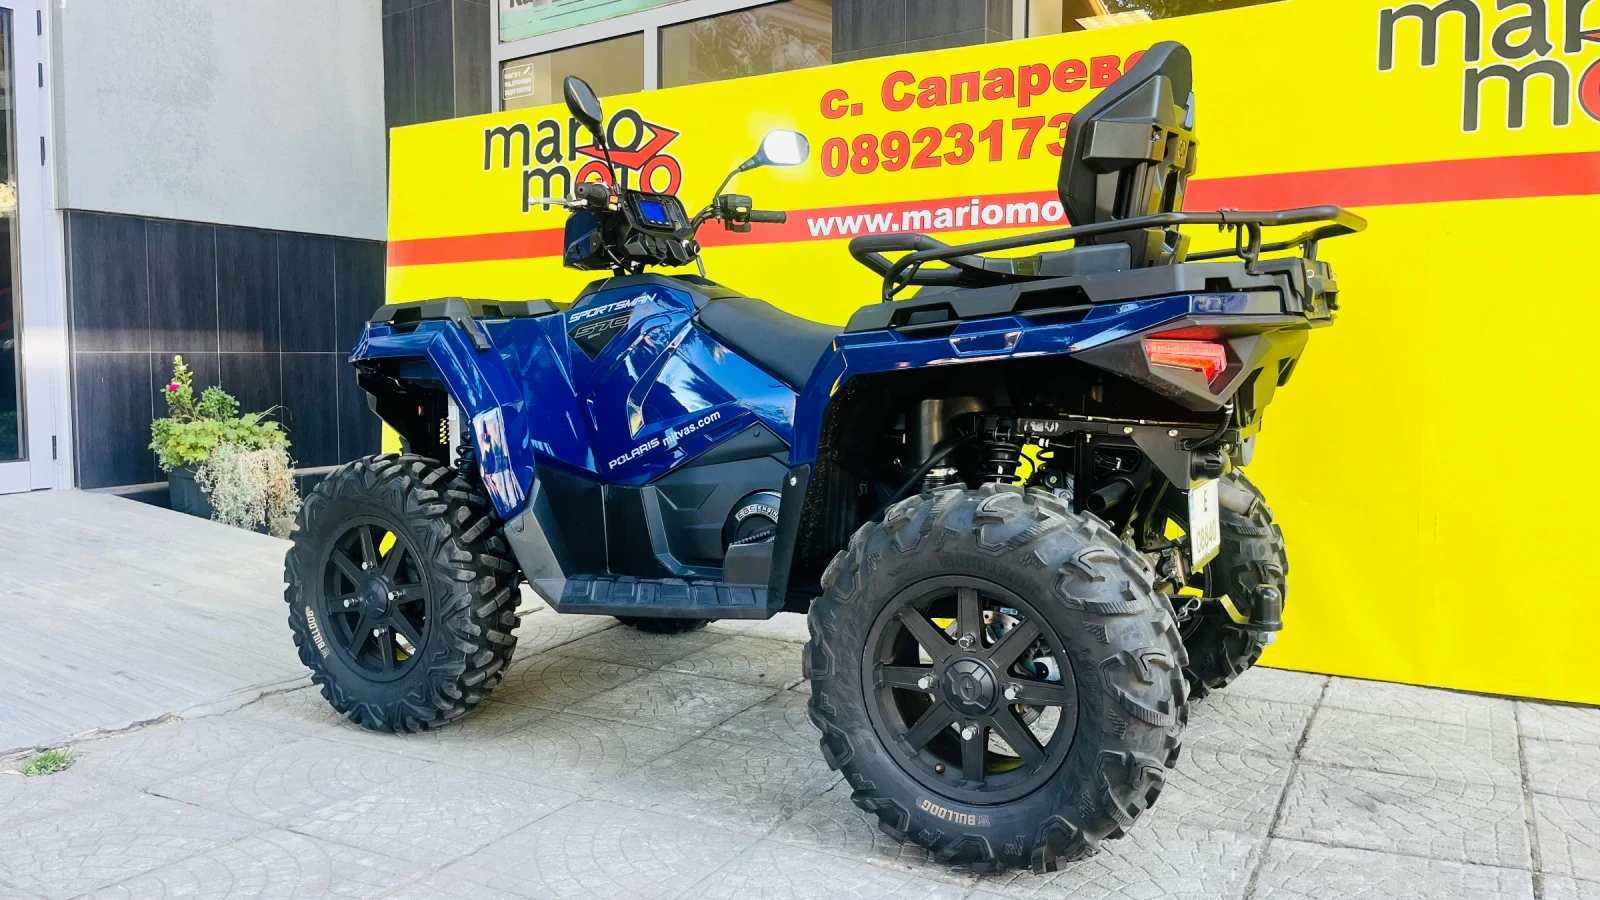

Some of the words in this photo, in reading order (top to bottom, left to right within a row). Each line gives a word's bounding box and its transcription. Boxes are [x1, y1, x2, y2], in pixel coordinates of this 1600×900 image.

[820, 89, 863, 119] с.
[1463, 57, 1600, 132] m
[807, 199, 1065, 237] www.mariomo
[568, 292, 657, 323] SPORTSMAN
[574, 314, 632, 338] 570
[662, 411, 721, 447] mitvas.com
[608, 437, 660, 470] POLARIS
[1203, 489, 1209, 512] E
[305, 605, 326, 651] BULLDOG
[921, 799, 976, 826] BULLDOG
